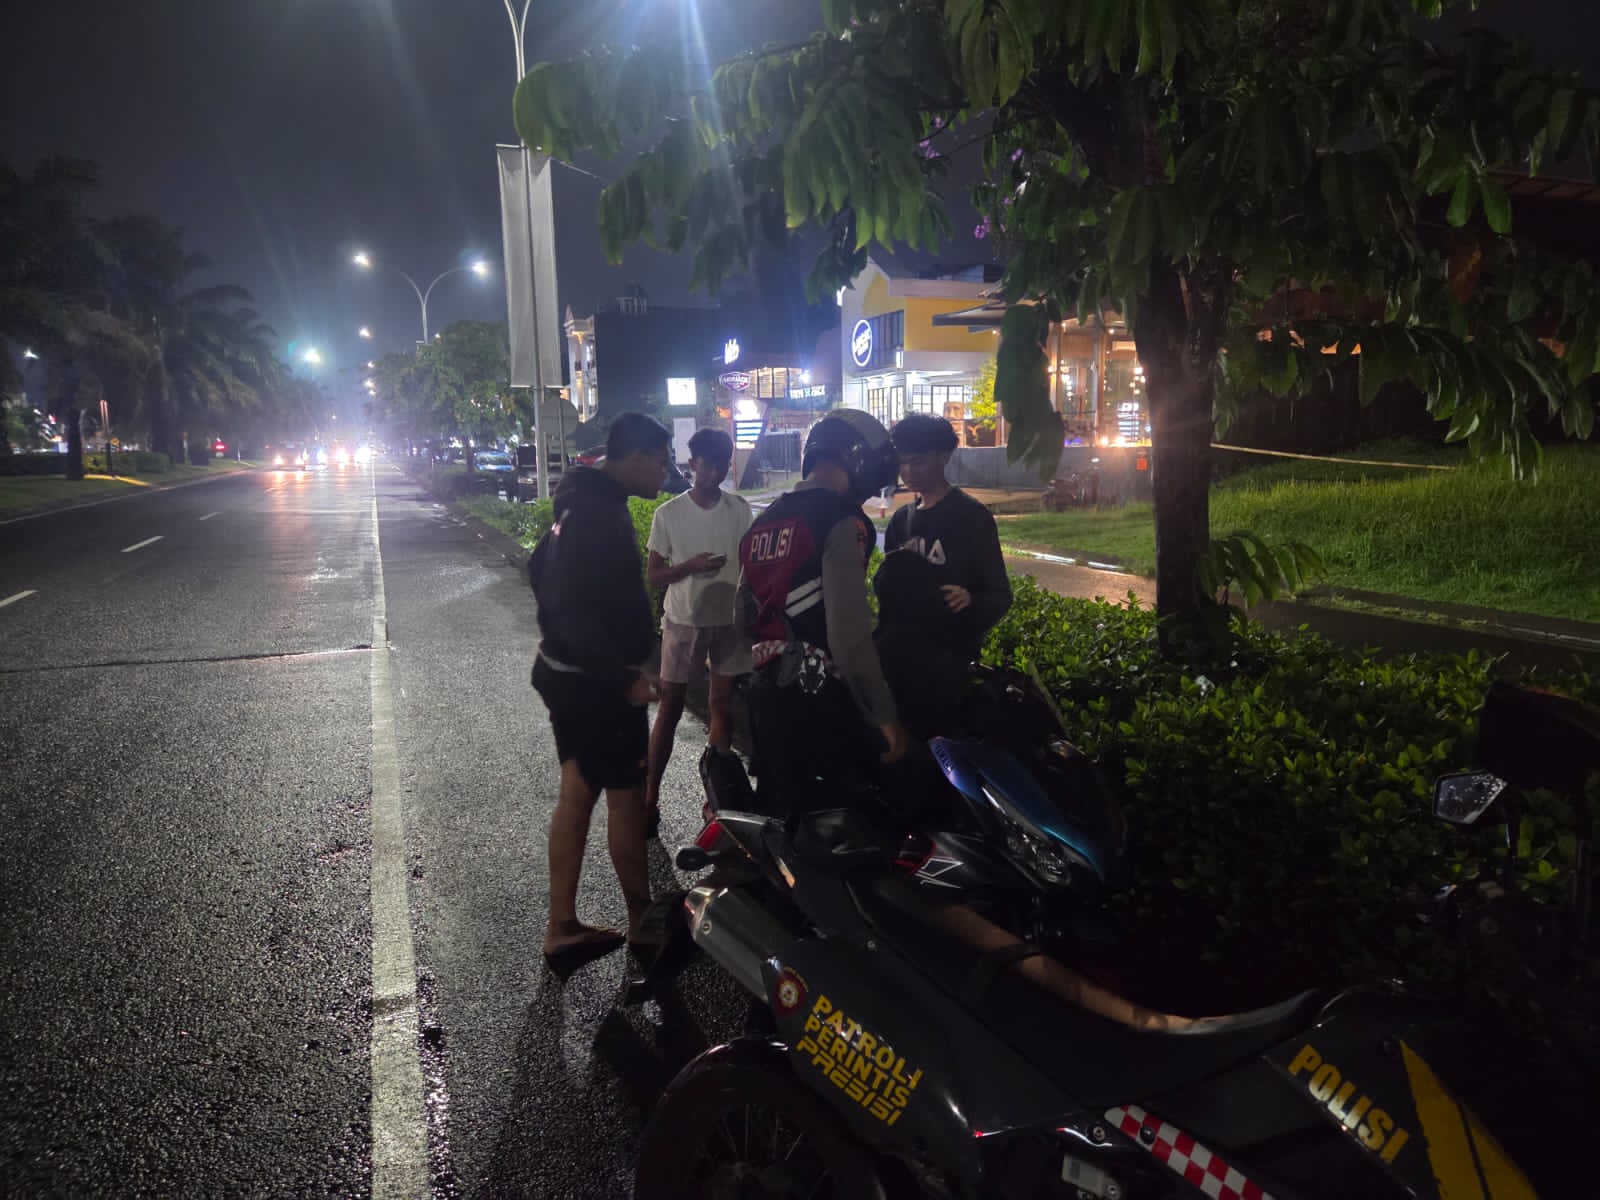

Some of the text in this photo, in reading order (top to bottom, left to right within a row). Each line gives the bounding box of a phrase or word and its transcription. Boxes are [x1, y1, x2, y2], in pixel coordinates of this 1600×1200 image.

[748, 527, 796, 561] POLISI
[796, 1035, 902, 1127] PRESISI
[804, 1014, 911, 1108] PERINTIS
[812, 994, 924, 1090] PATROLI
[1288, 1043, 1410, 1164] POLISI
